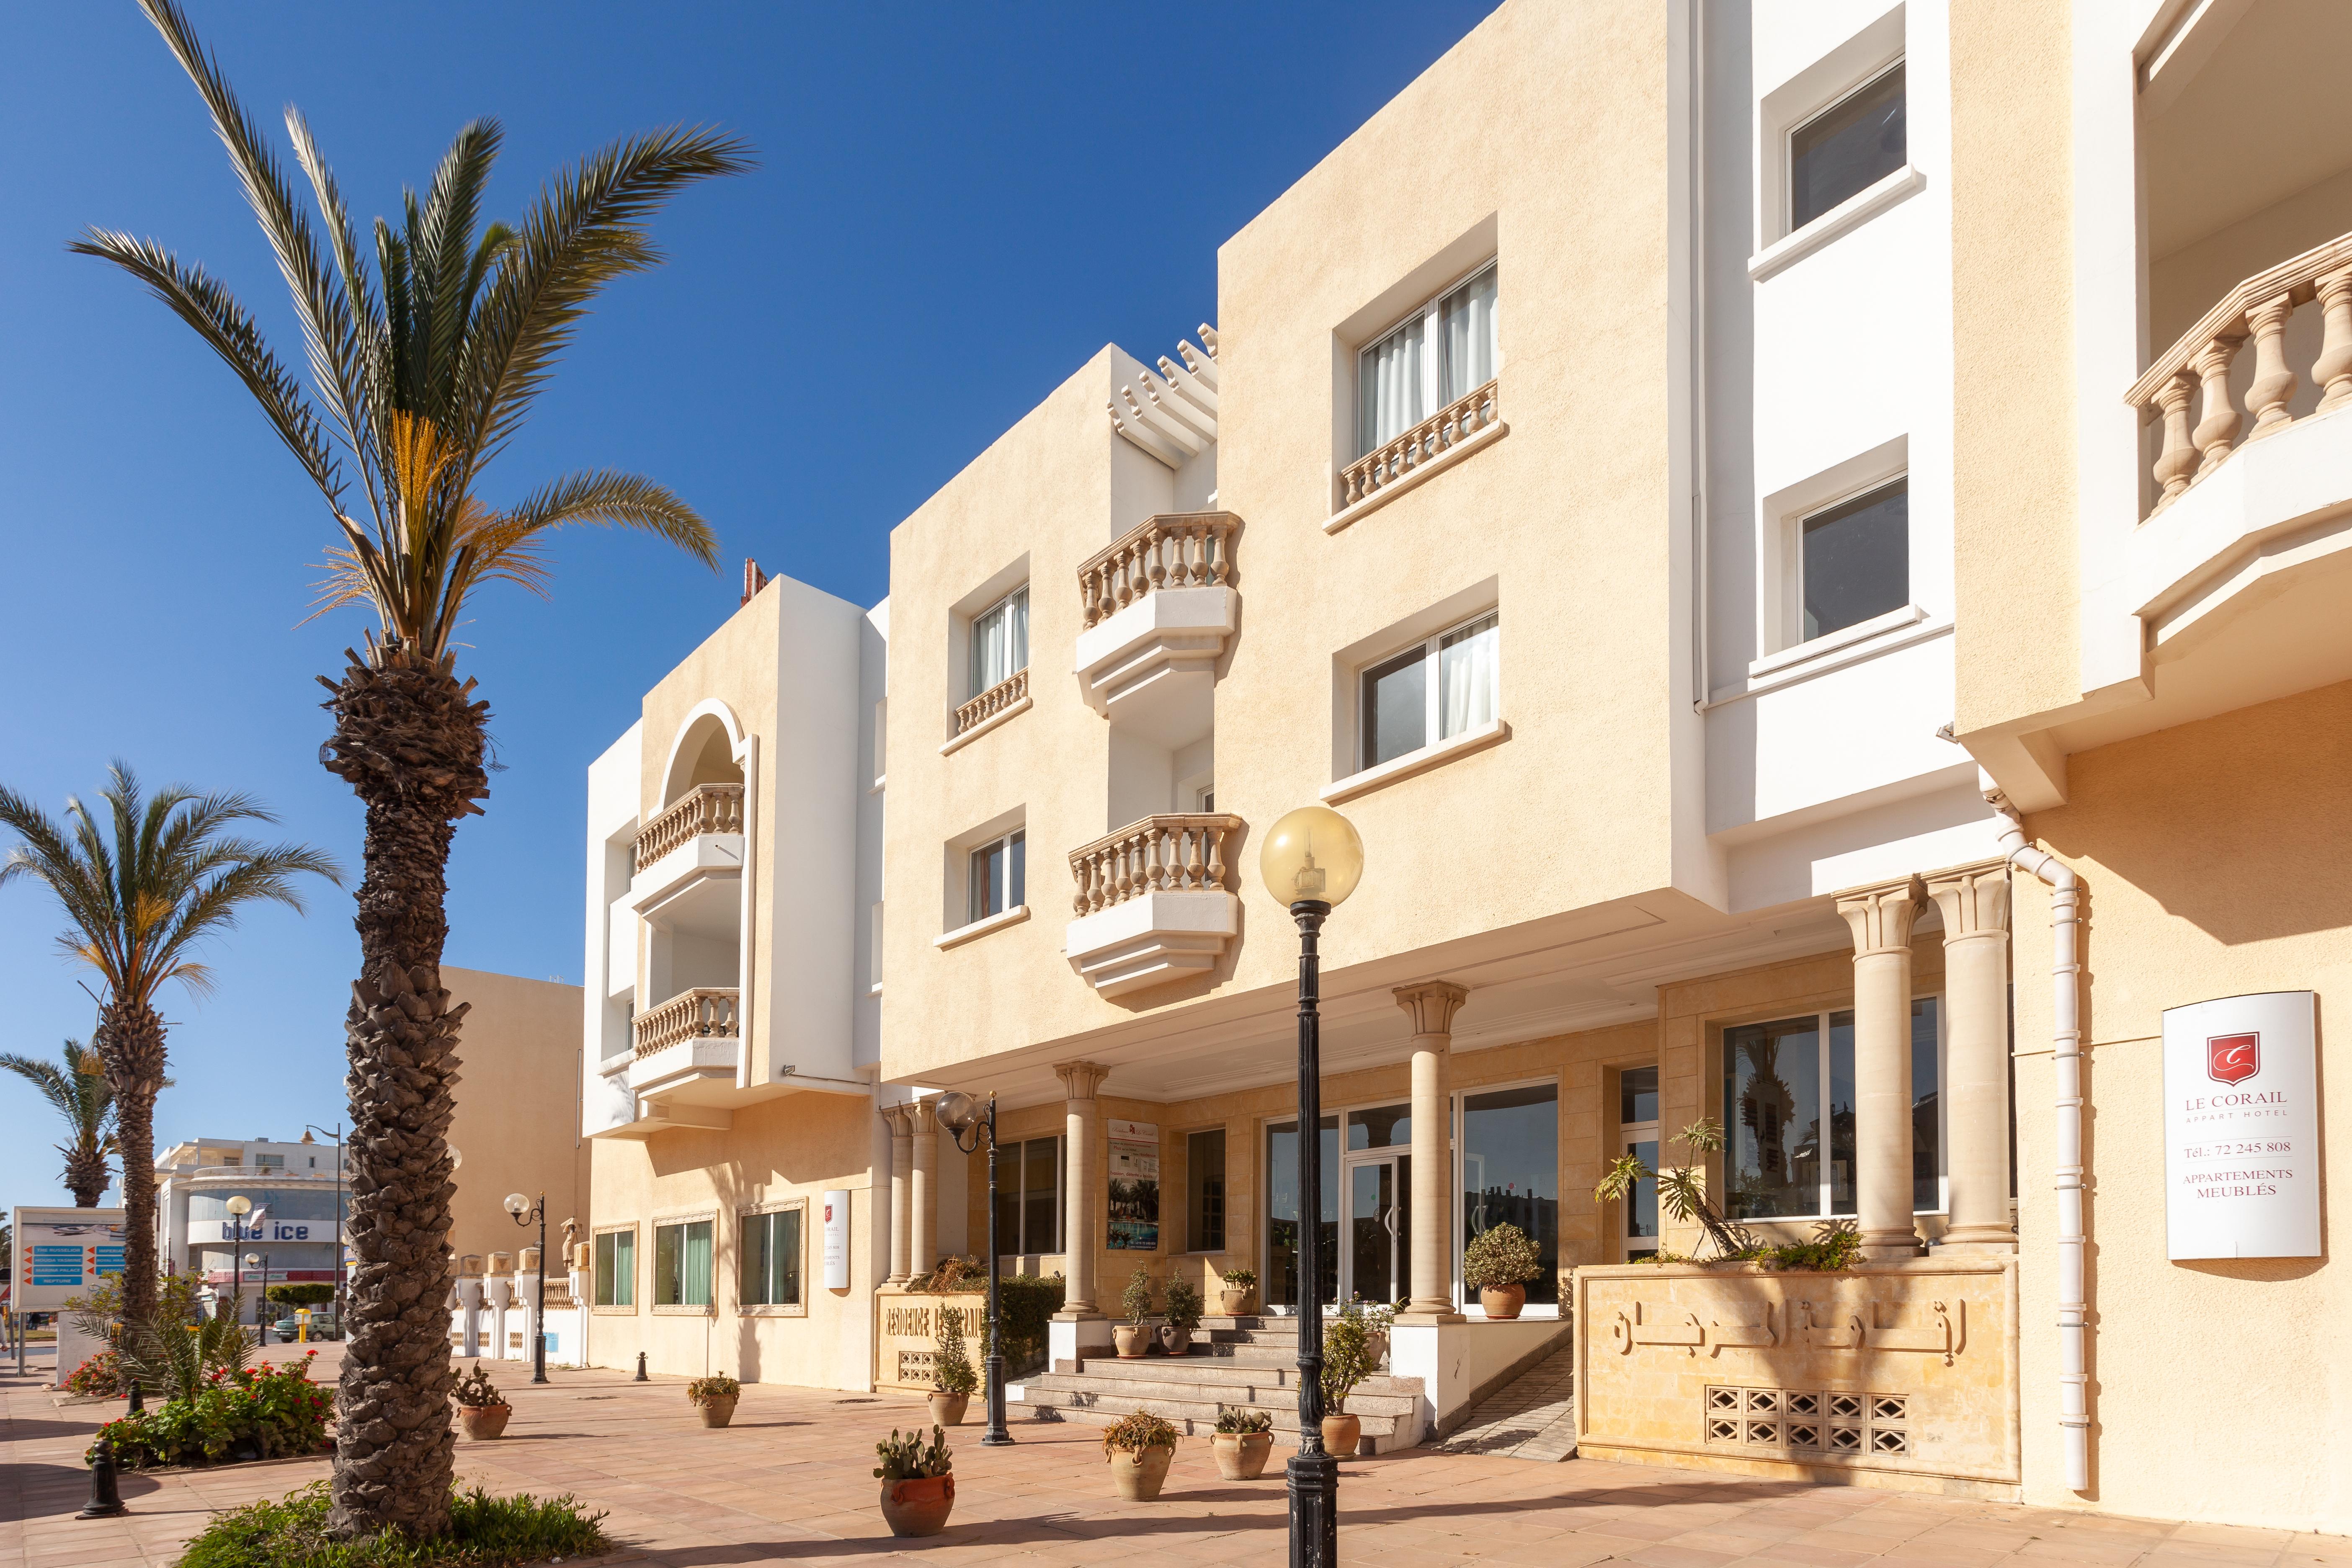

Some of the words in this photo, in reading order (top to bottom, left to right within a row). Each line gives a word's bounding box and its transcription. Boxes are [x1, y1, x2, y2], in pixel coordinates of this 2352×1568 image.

[2186, 1098, 2205, 1111] LE
[2212, 1091, 2288, 1107] CORAIL
[2186, 1112, 2234, 1123] APPART
[2215, 1145, 2231, 1155] 72
[2236, 1143, 2261, 1154] 245
[2267, 1141, 2291, 1153] 808
[2183, 1169, 2293, 1184] APPARTEMENTS
[2197, 1182, 2277, 1199] MEUBLÉS
[222, 1221, 263, 1240] blue
[274, 1221, 309, 1240] ice
[885, 1307, 929, 1337] RESIDENCE
[1613, 1299, 1789, 1359] المرجان
[1800, 1298, 1966, 1367] إقامة
